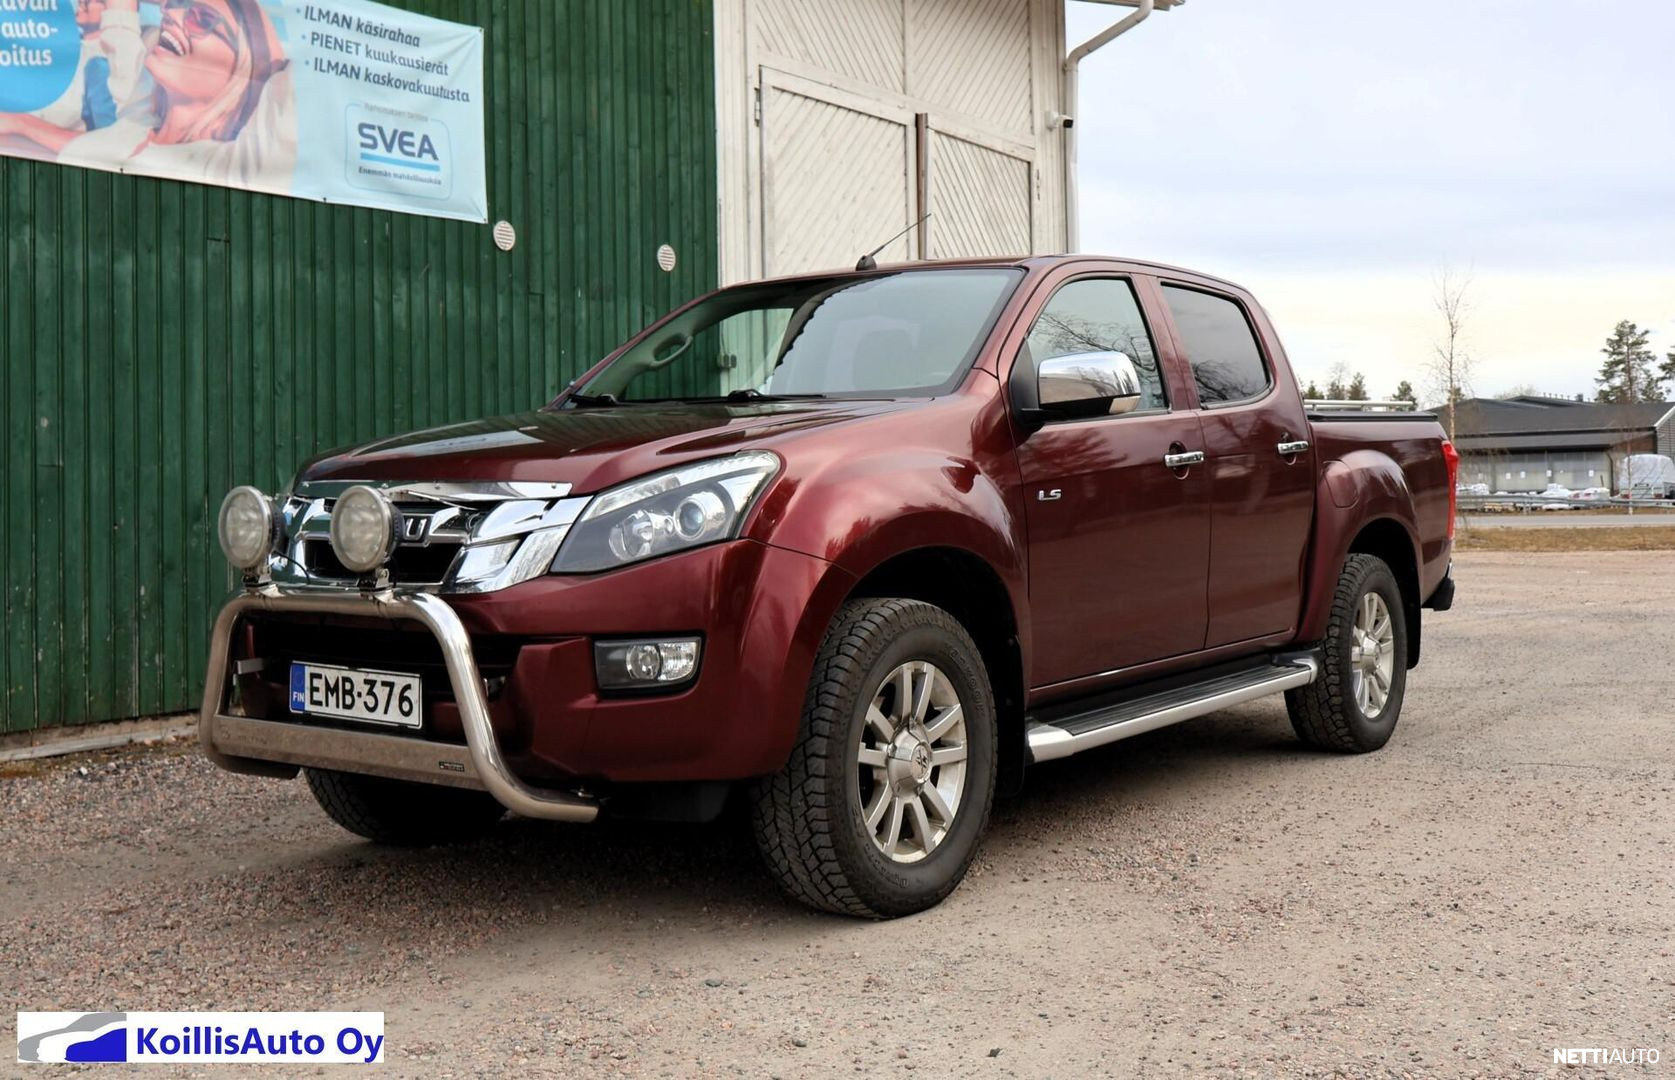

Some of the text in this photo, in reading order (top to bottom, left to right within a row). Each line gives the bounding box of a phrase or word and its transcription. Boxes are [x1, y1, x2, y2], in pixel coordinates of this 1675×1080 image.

[0, 0, 57, 11] avan
[1, 19, 58, 38] auto-
[304, 5, 420, 48] ILMAN käsirahaa
[0, 44, 53, 66] oitus
[311, 31, 448, 76] PIENET kuukausierät
[314, 57, 470, 102] ILMAN kaskovakuutusta
[358, 122, 439, 161] SVEA
[1039, 489, 1062, 501] LS
[293, 691, 304, 703] FIN
[309, 672, 414, 718] EMB-376
